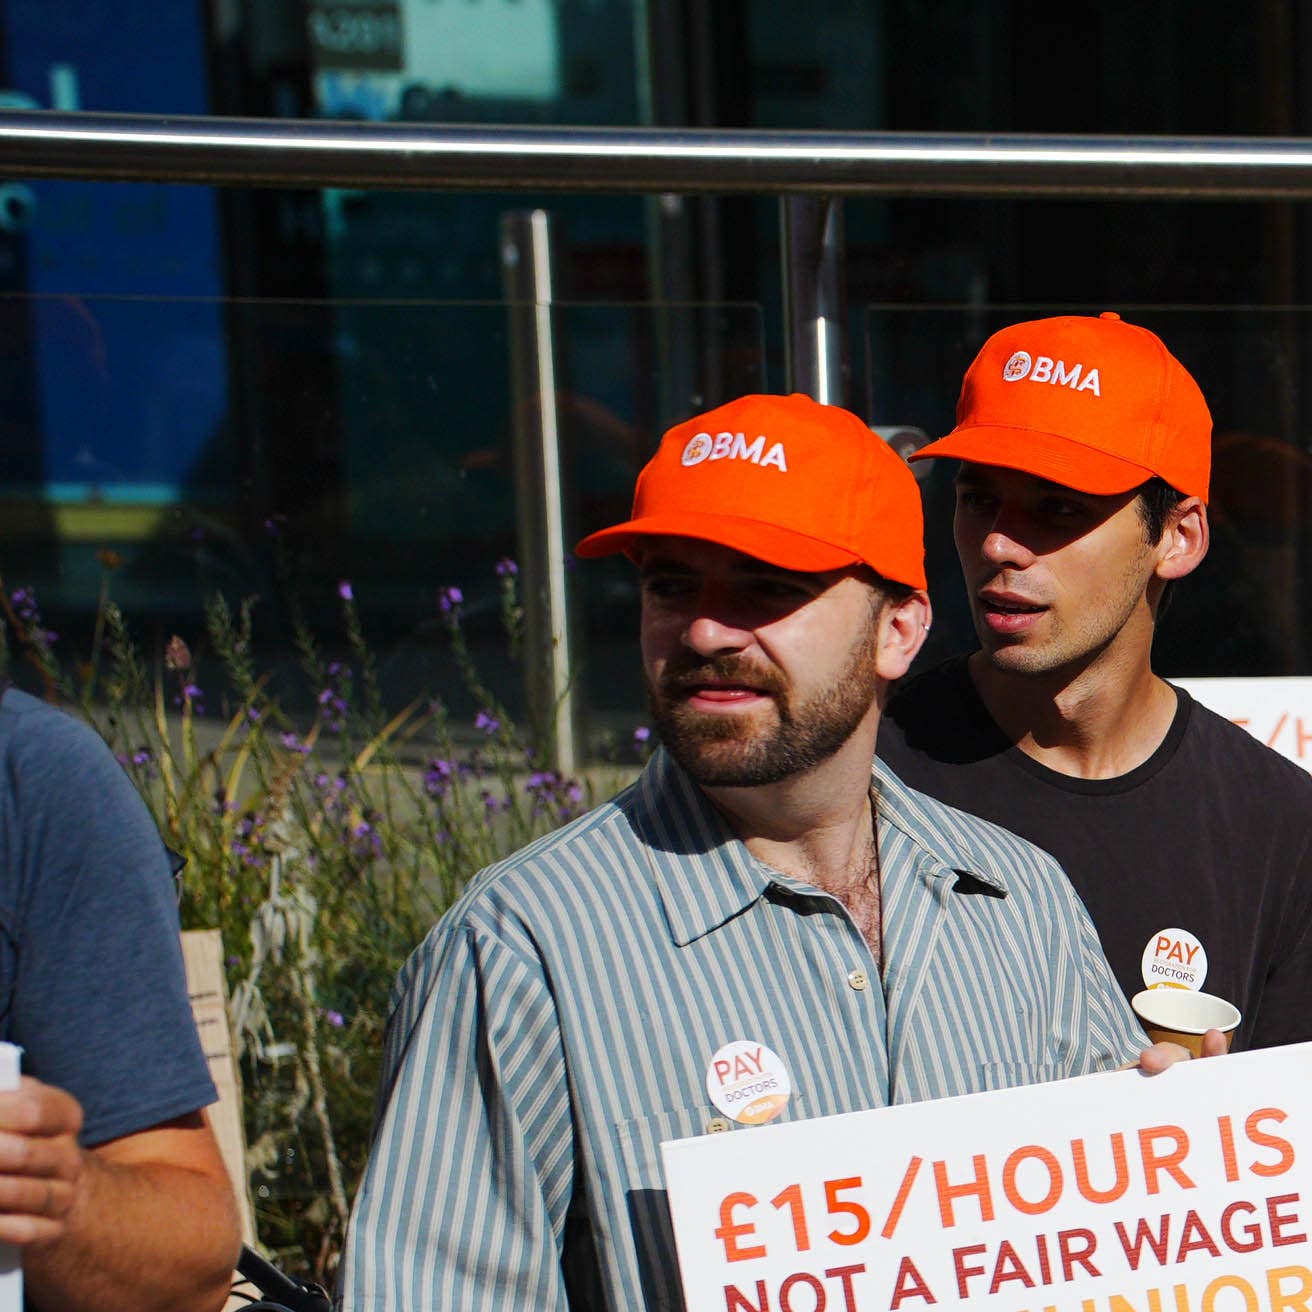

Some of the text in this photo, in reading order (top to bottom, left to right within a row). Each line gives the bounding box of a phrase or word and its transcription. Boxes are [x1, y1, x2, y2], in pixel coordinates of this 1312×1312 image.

[1031, 355, 1101, 398] BMA
[713, 432, 787, 473] BMA
[1155, 936, 1200, 966] PAY
[1152, 964, 1195, 983] DOCTORS
[713, 1047, 765, 1087] PAY
[725, 1078, 778, 1104] DOCTORS
[715, 1107, 1296, 1264] £15/HOUR IS
[889, 1256, 938, 1310] A
[951, 1226, 1102, 1298] FAIR
[1113, 1193, 1308, 1271] WAGE
